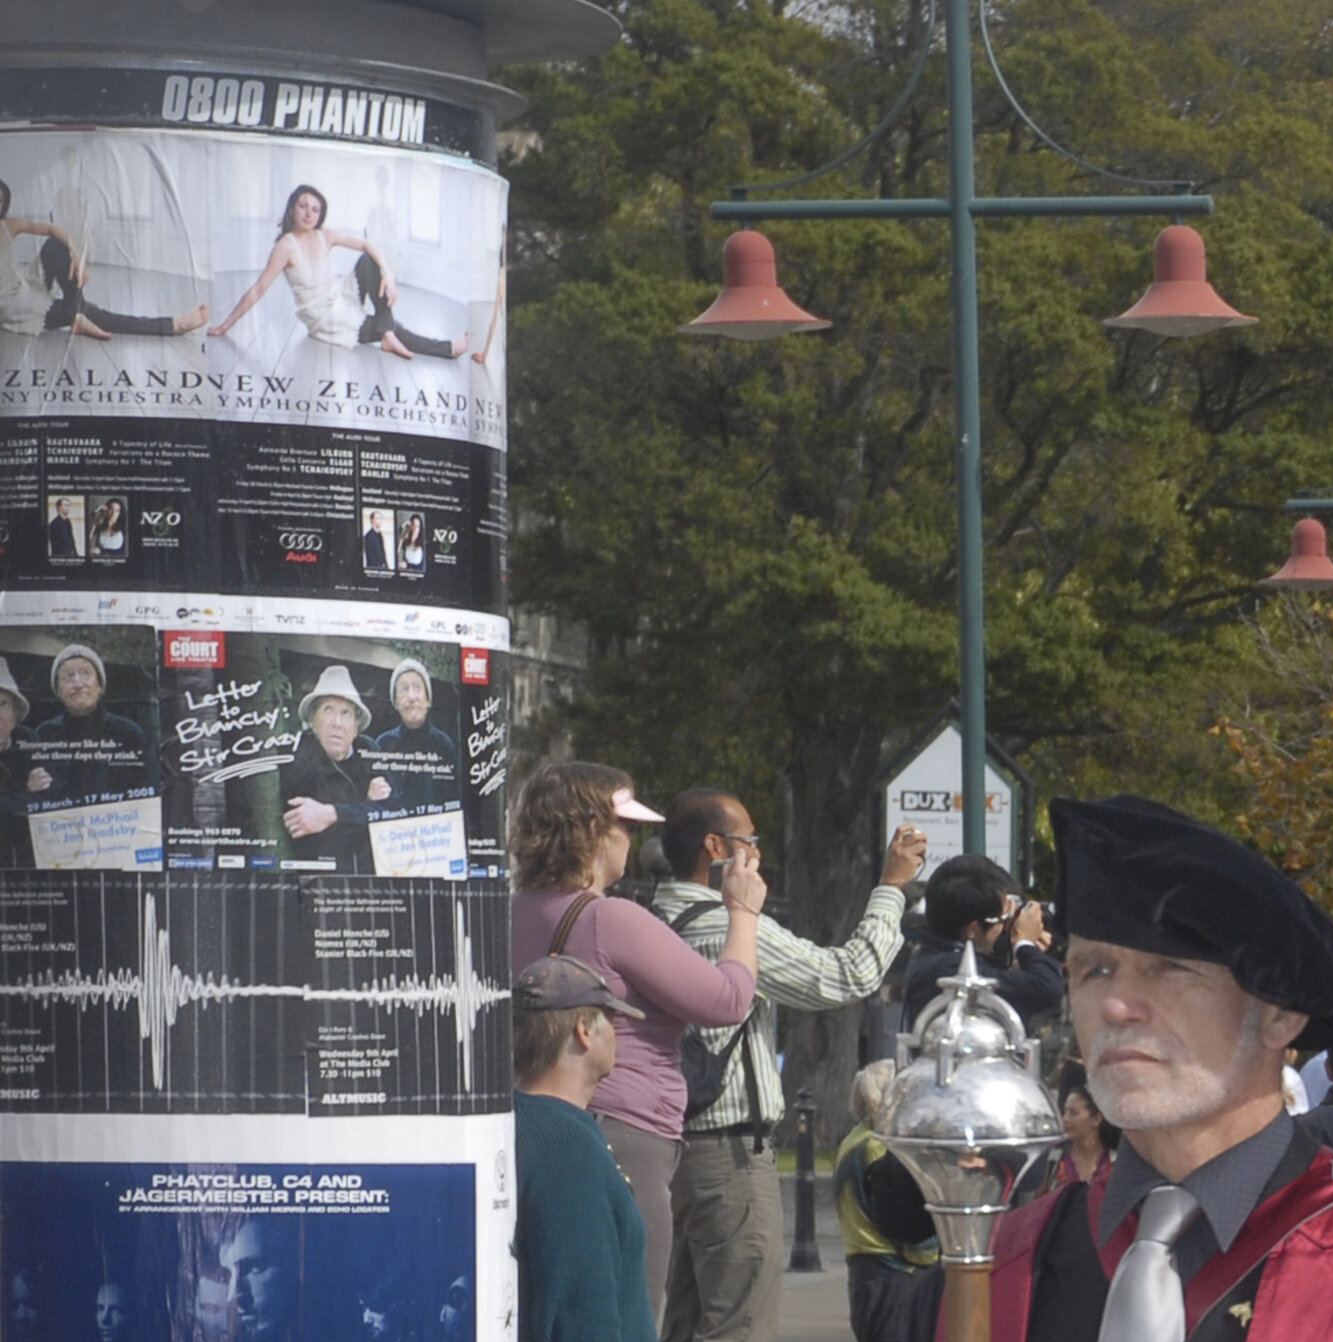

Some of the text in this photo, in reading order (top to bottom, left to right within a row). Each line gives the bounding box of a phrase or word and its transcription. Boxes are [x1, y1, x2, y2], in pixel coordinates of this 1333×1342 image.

[161, 75, 426, 144] 0800 PHANTOM
[4, 369, 203, 389] ZEALAND
[44, 391, 203, 405] ORCHESTRA
[207, 373, 468, 412] NEW ZEALAND
[218, 394, 346, 413] YMPHONY
[357, 404, 468, 428] ORCHESTRA
[170, 641, 219, 657] COURT
[185, 680, 262, 710] Letter
[220, 704, 240, 719] to
[175, 707, 291, 744] Blanchy:
[232, 730, 303, 755] Crazy
[179, 747, 231, 771] Stir
[84, 794, 97, 804] 17
[101, 792, 124, 803] May
[416, 805, 426, 815] 17
[322, 1092, 386, 1105] ALTMUSIC
[152, 1174, 361, 1190] PHATCLUB, C4 AND
[119, 1188, 390, 1203] JÄGERMEISTER PRESENT:
